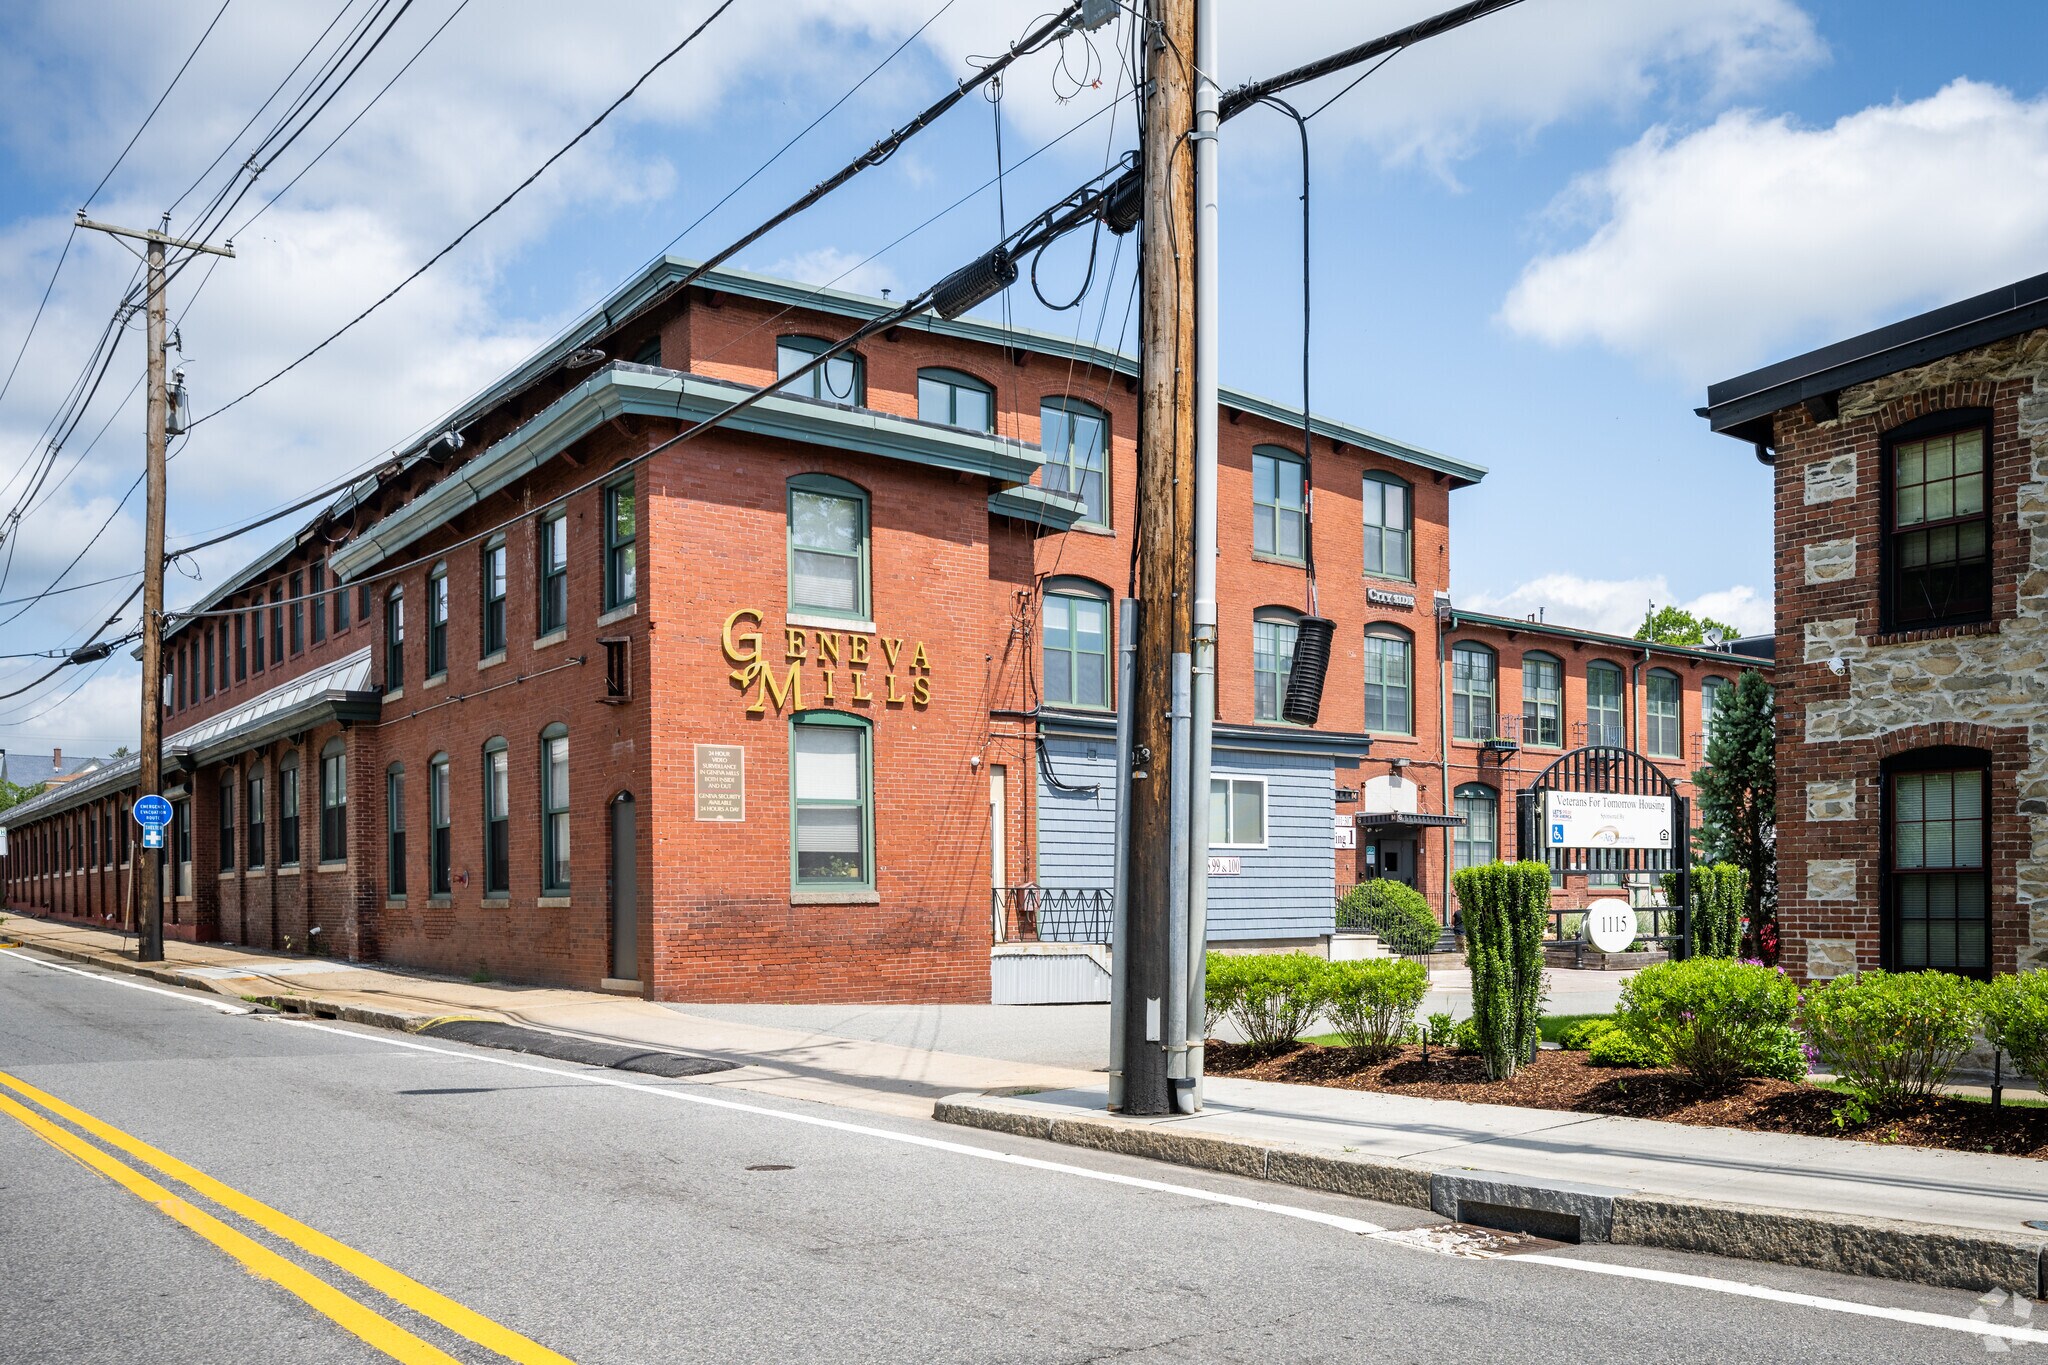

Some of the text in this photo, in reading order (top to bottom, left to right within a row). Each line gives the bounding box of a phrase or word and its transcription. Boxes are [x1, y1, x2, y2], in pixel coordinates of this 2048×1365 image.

[1368, 589, 1414, 606] CITY SIDE
[722, 608, 932, 688] GENEVA
[746, 660, 931, 712] MILLS
[1556, 795, 1665, 813] Veterans For Tomorrow Housing
[1211, 859, 1220, 872] 99
[1229, 859, 1240, 873] 100
[1601, 915, 1627, 933] 1115
